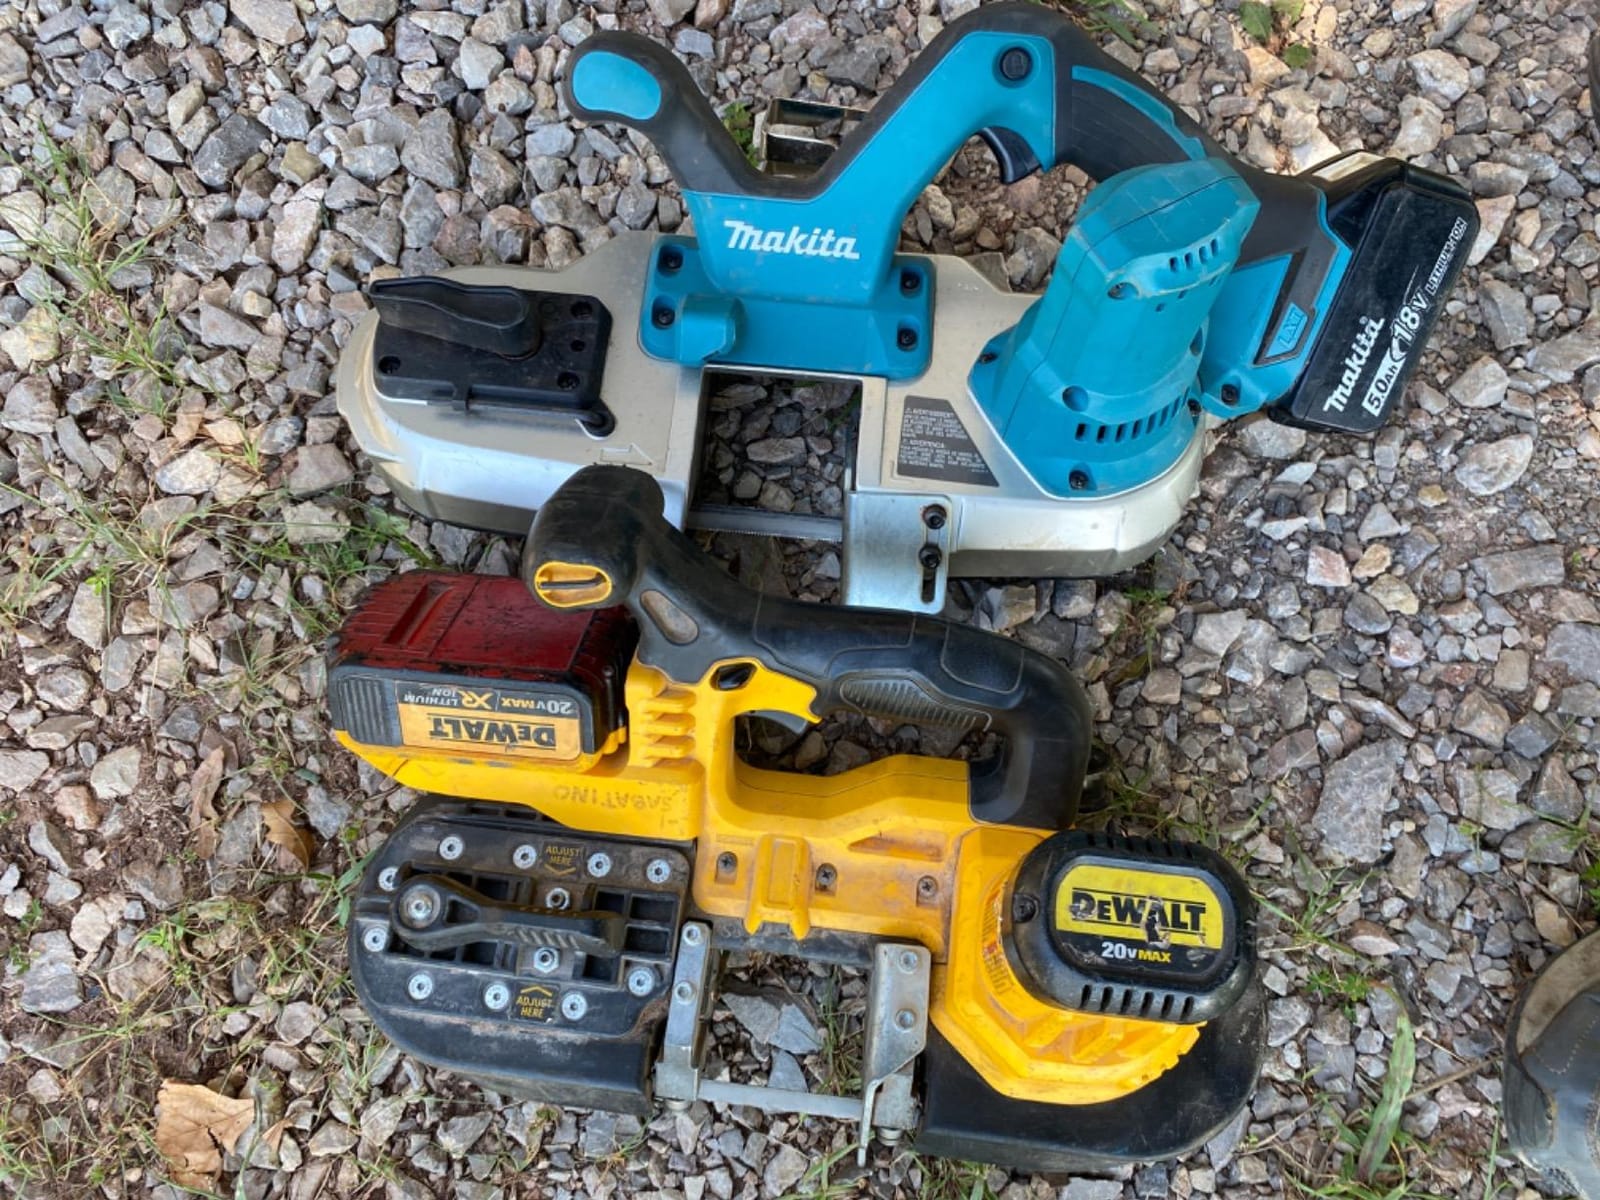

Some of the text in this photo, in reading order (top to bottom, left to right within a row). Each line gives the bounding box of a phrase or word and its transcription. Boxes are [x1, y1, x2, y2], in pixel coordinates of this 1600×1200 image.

[1279, 306, 1306, 346] LXT
[432, 687, 457, 698] ION
[403, 694, 458, 707] LITHIUM
[457, 690, 495, 711] XR
[546, 845, 581, 857] ADJUST
[550, 856, 572, 866] HERE
[1138, 950, 1172, 964] MAX
[516, 995, 553, 1009] ADJUST
[520, 1006, 545, 1018] HERE
